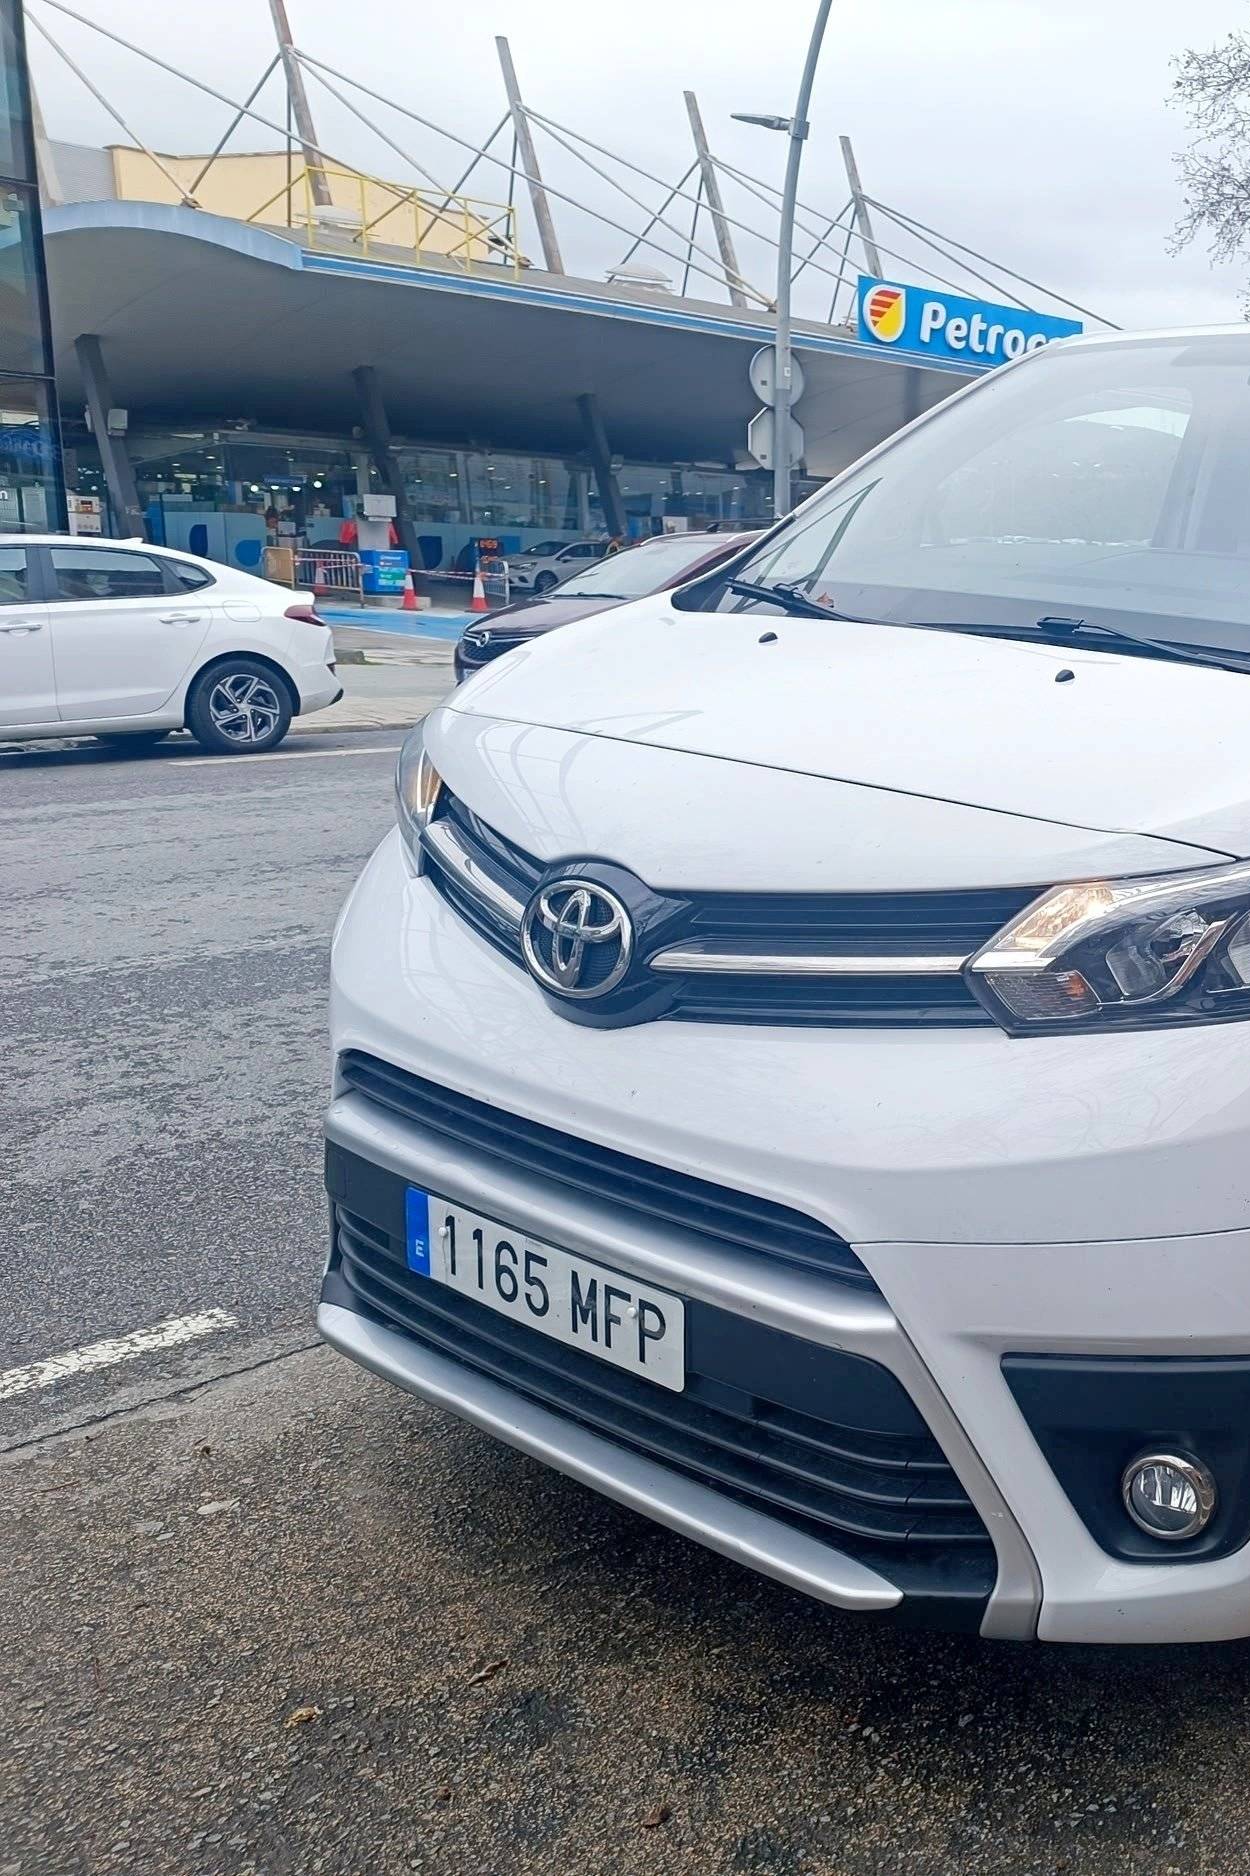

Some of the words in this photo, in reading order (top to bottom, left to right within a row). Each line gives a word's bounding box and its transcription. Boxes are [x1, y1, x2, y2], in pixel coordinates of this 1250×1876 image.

[920, 301, 1063, 360] Petroc
[415, 1238, 425, 1258] E
[445, 1214, 550, 1317] 1165
[571, 1269, 666, 1364] MFP
